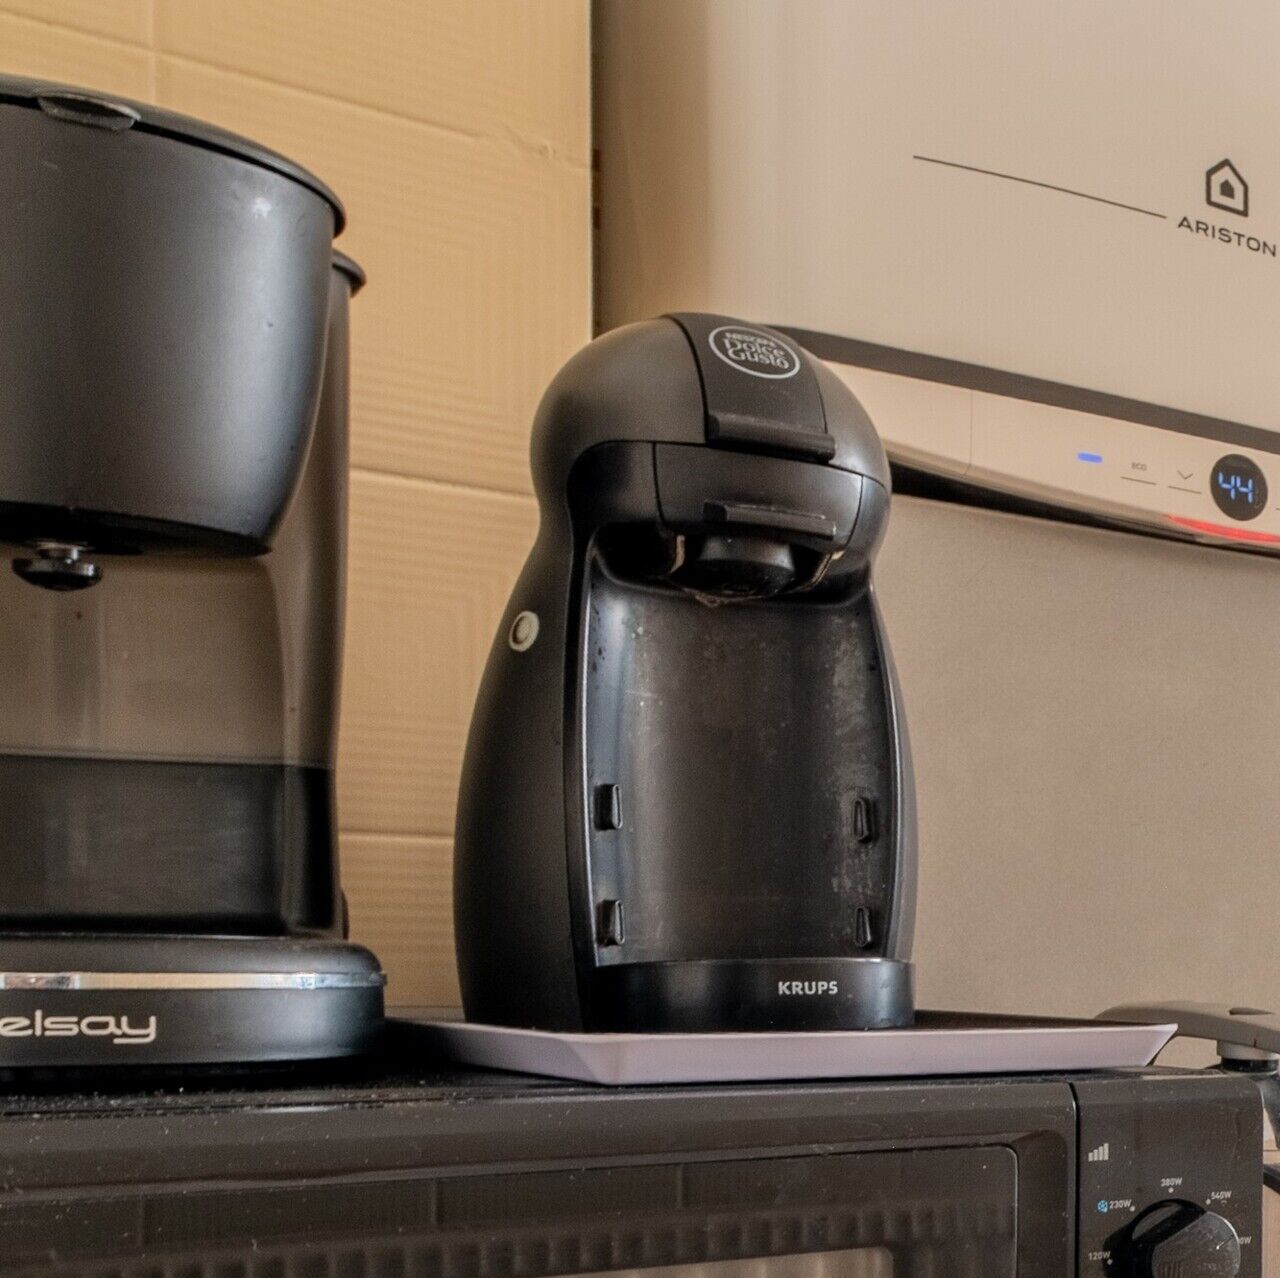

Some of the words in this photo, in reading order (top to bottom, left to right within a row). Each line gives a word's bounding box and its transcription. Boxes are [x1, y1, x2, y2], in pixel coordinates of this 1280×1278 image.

[1178, 216, 1276, 257] ARISTON
[727, 348, 789, 369] Gusto
[1131, 462, 1147, 472] ECO
[1218, 472, 1253, 503] 44
[778, 981, 838, 995] KRUPS
